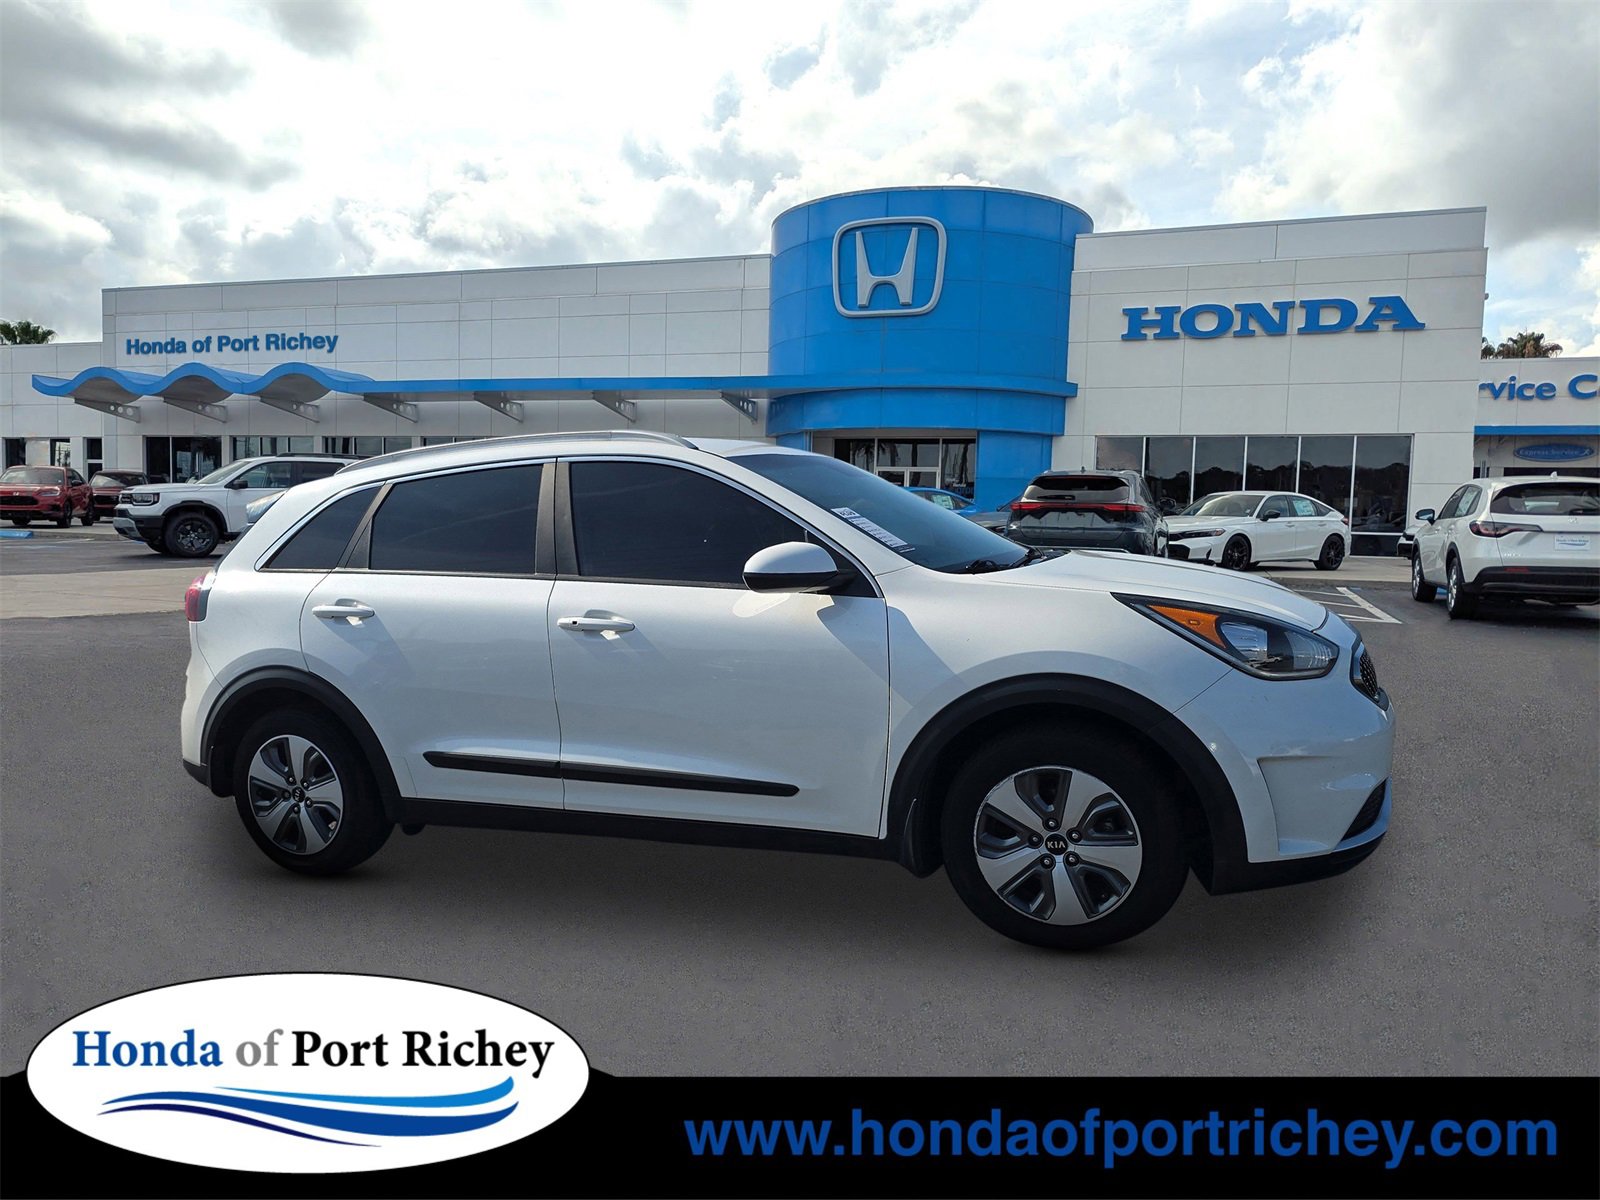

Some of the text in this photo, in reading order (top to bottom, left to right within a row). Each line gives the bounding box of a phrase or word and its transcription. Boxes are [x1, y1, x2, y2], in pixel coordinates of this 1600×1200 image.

[1120, 295, 1425, 341] HONDA
[125, 331, 338, 355] Honda of Port Richey
[1047, 841, 1066, 849] KIA
